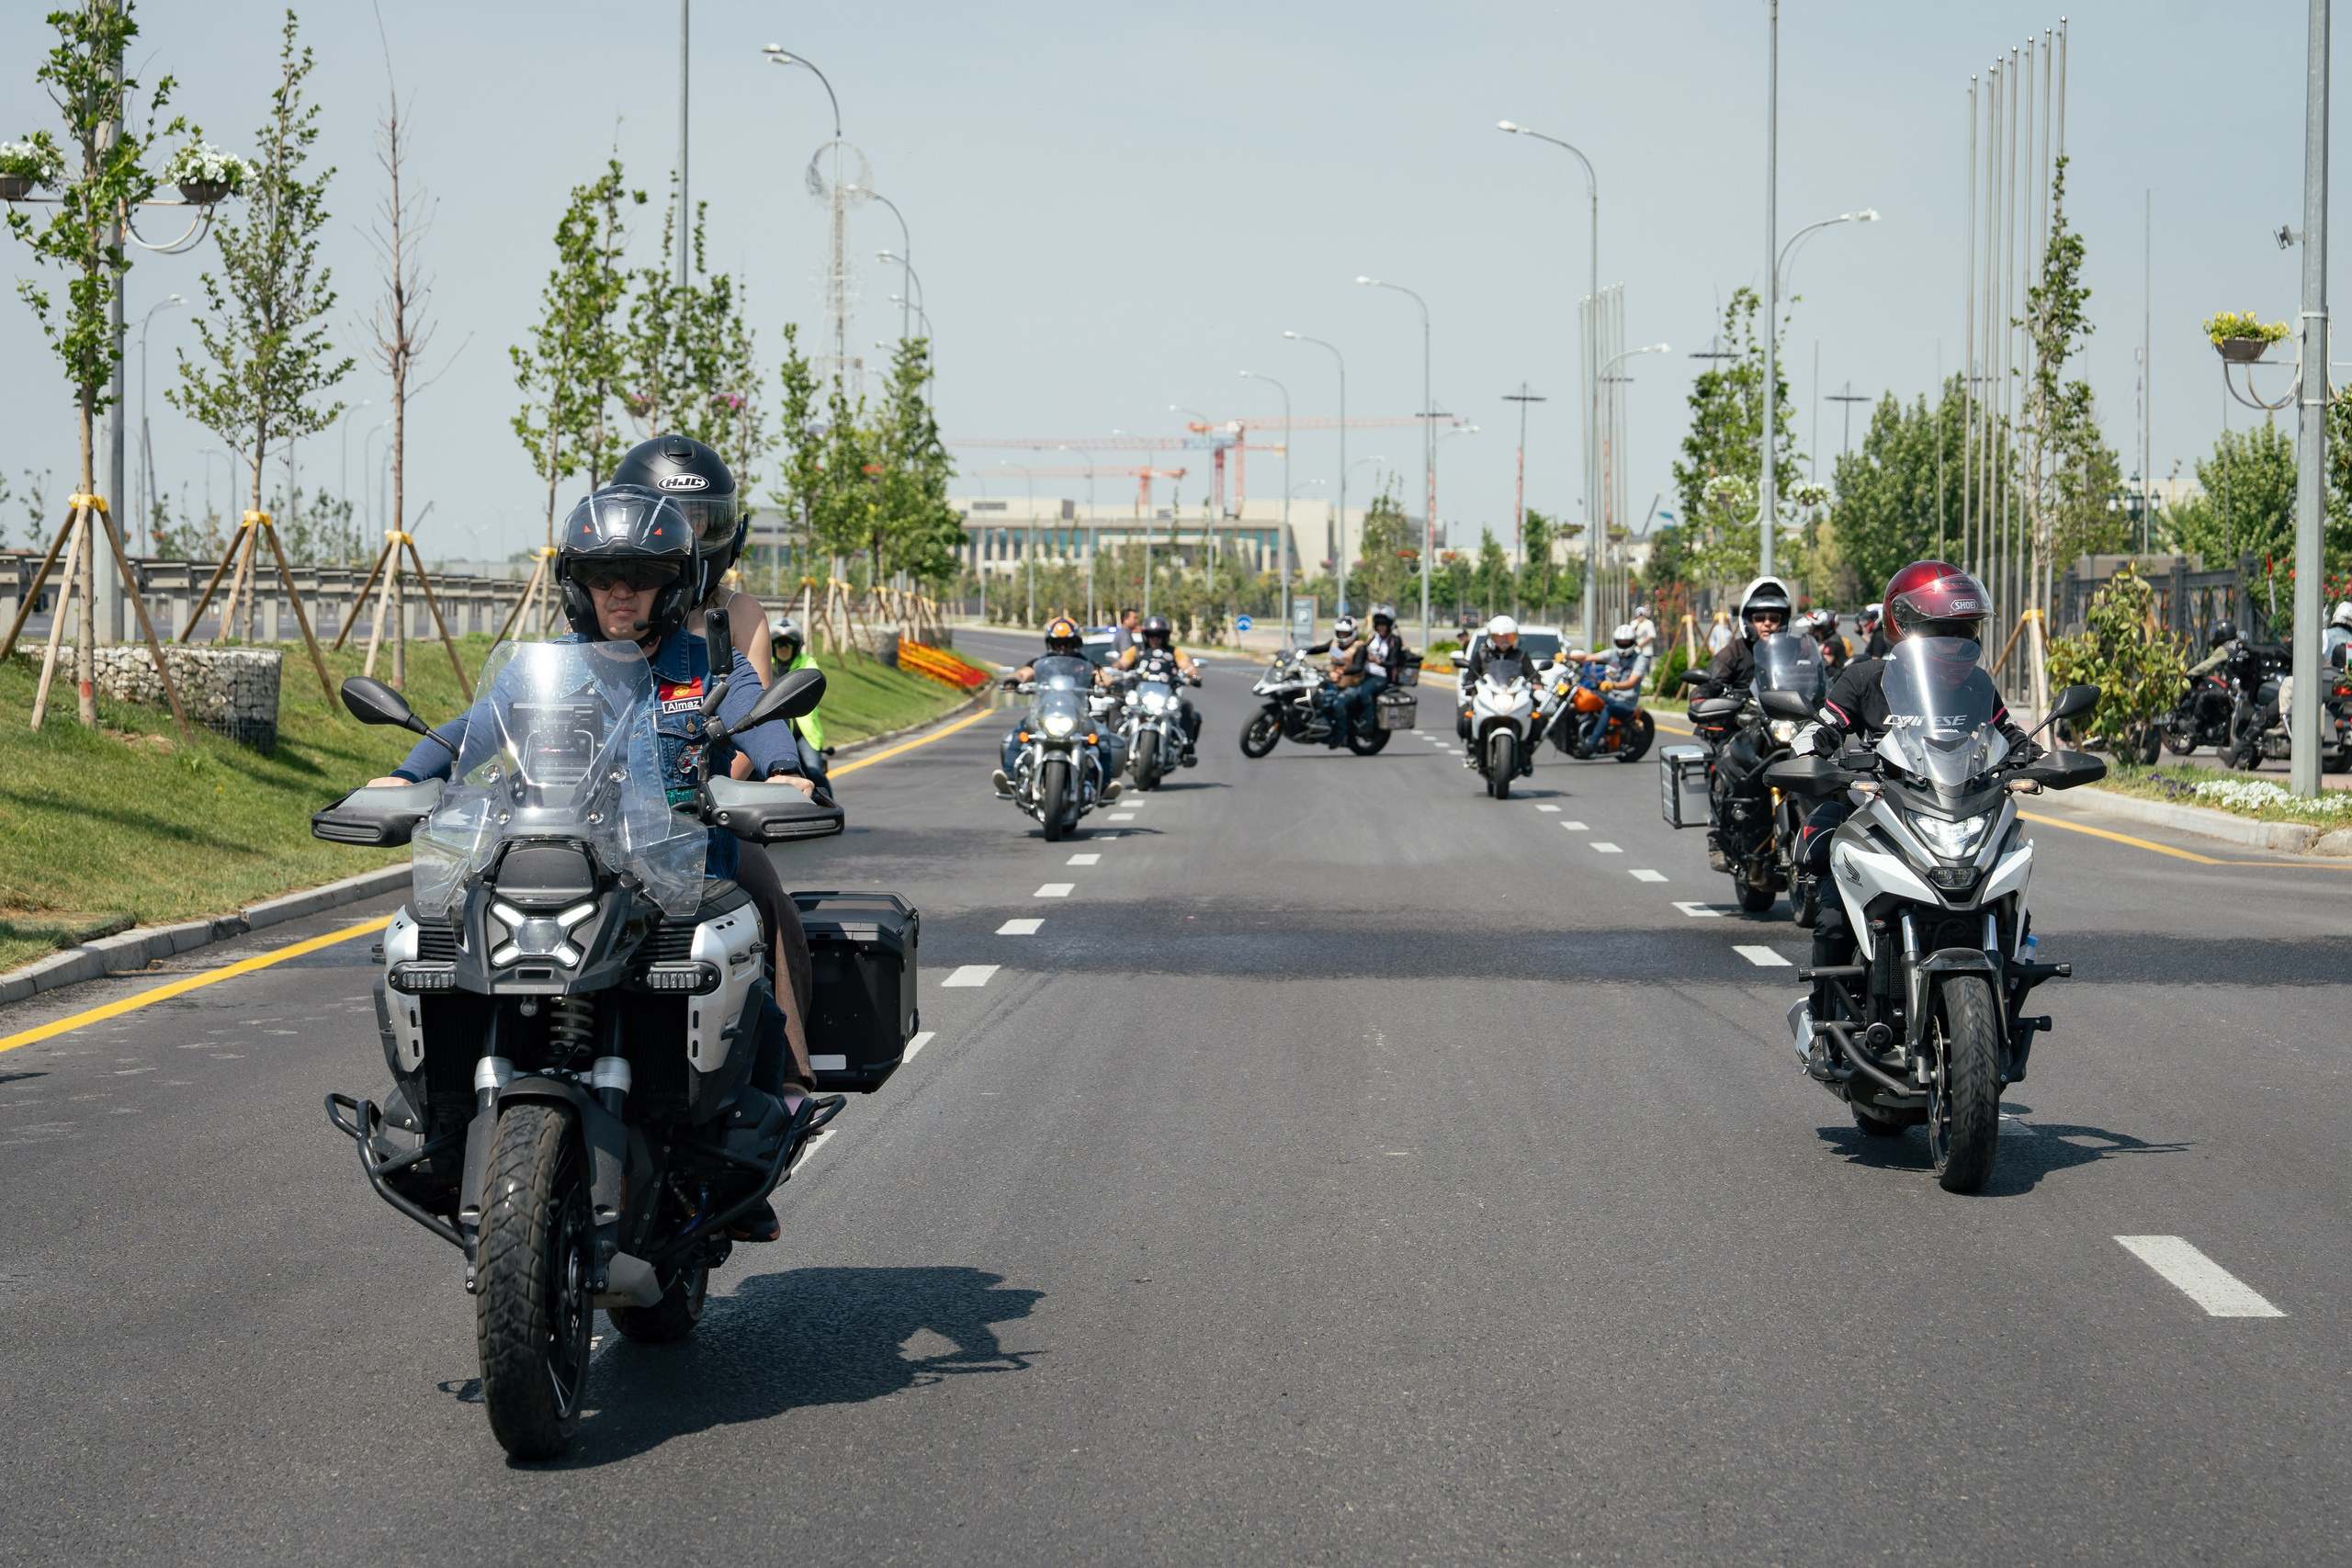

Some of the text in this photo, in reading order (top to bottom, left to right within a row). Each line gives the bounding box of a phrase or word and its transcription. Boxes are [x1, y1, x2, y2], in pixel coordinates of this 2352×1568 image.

[665, 478, 703, 487] HJC
[1955, 601, 1976, 610] SHOEI
[668, 700, 700, 711] Almaz
